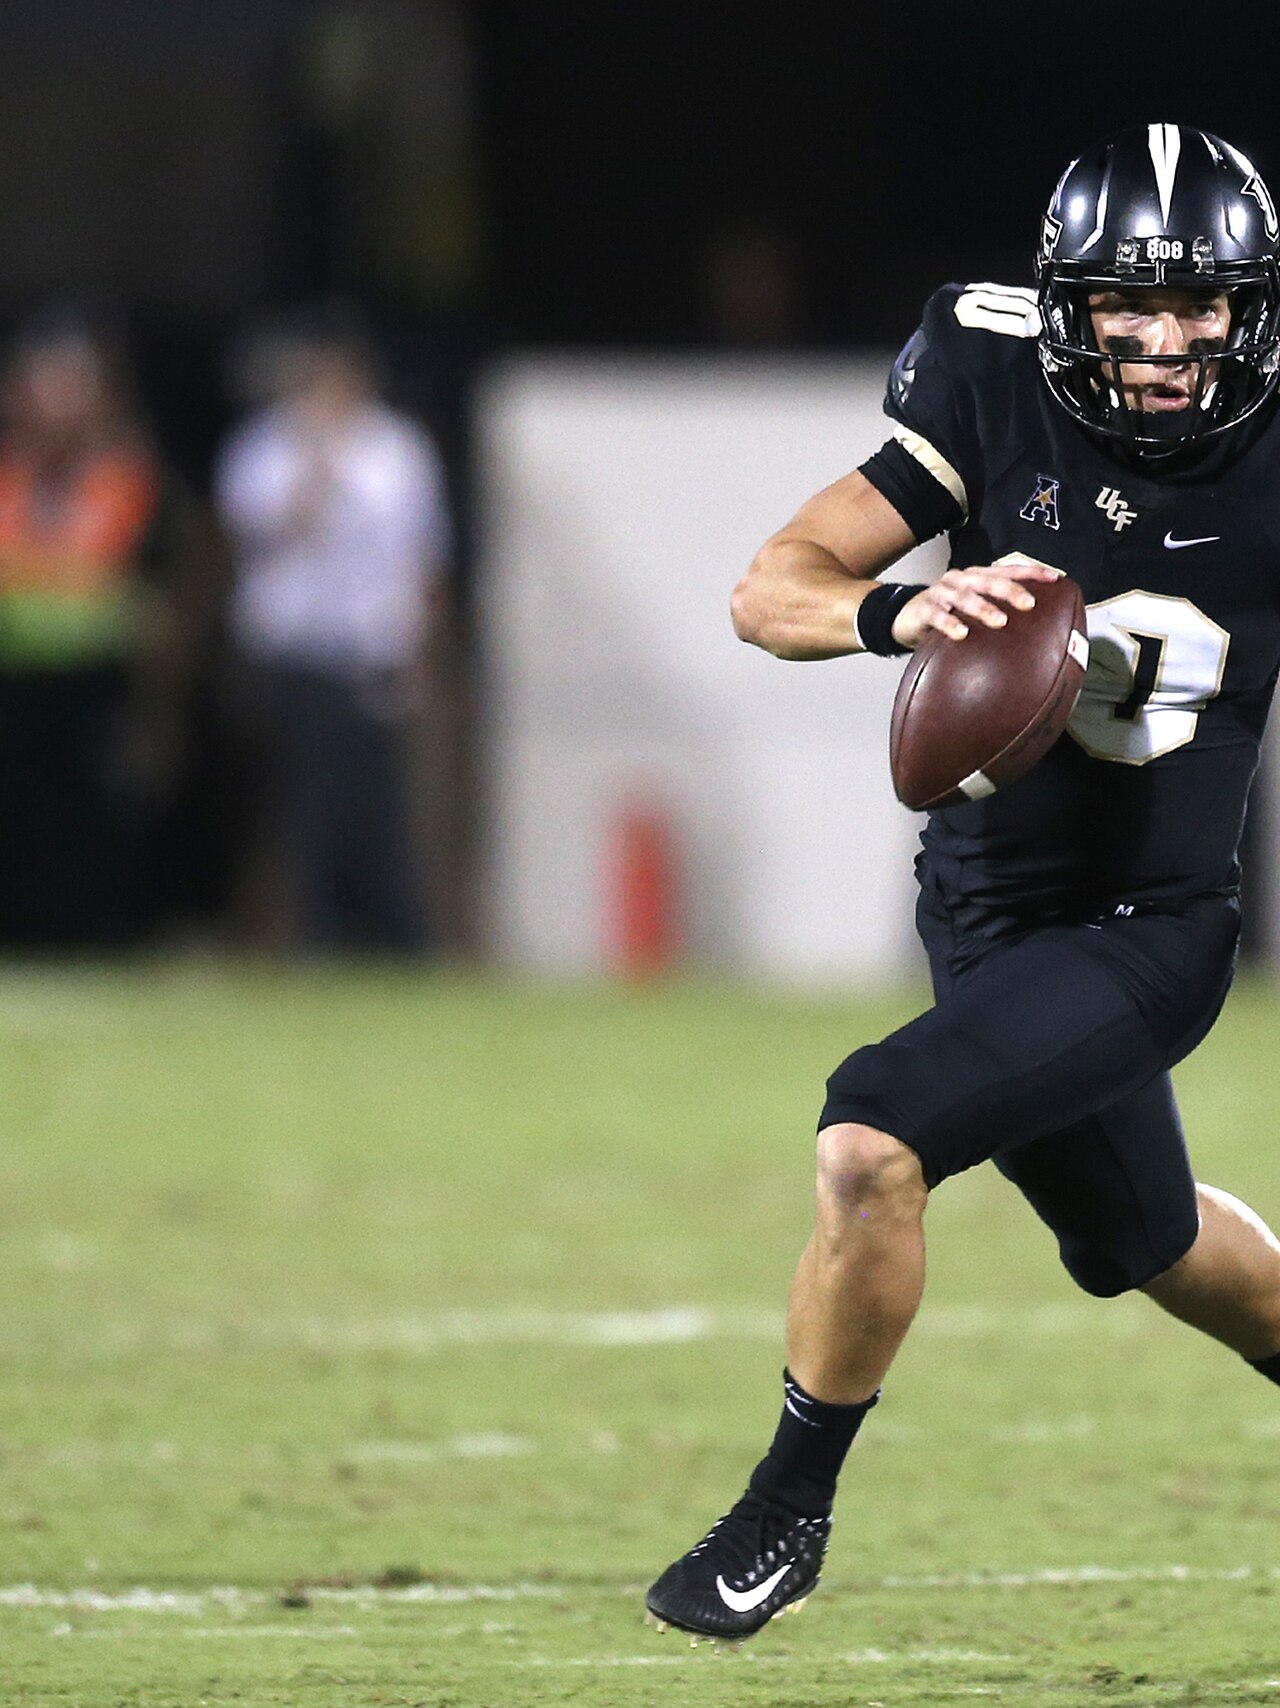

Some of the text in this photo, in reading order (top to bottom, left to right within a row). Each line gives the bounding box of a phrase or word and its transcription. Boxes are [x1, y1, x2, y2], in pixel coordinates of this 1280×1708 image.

[1147, 240, 1184, 260] 808
[1095, 486, 1138, 531] UCF
[1115, 904, 1135, 917] M
